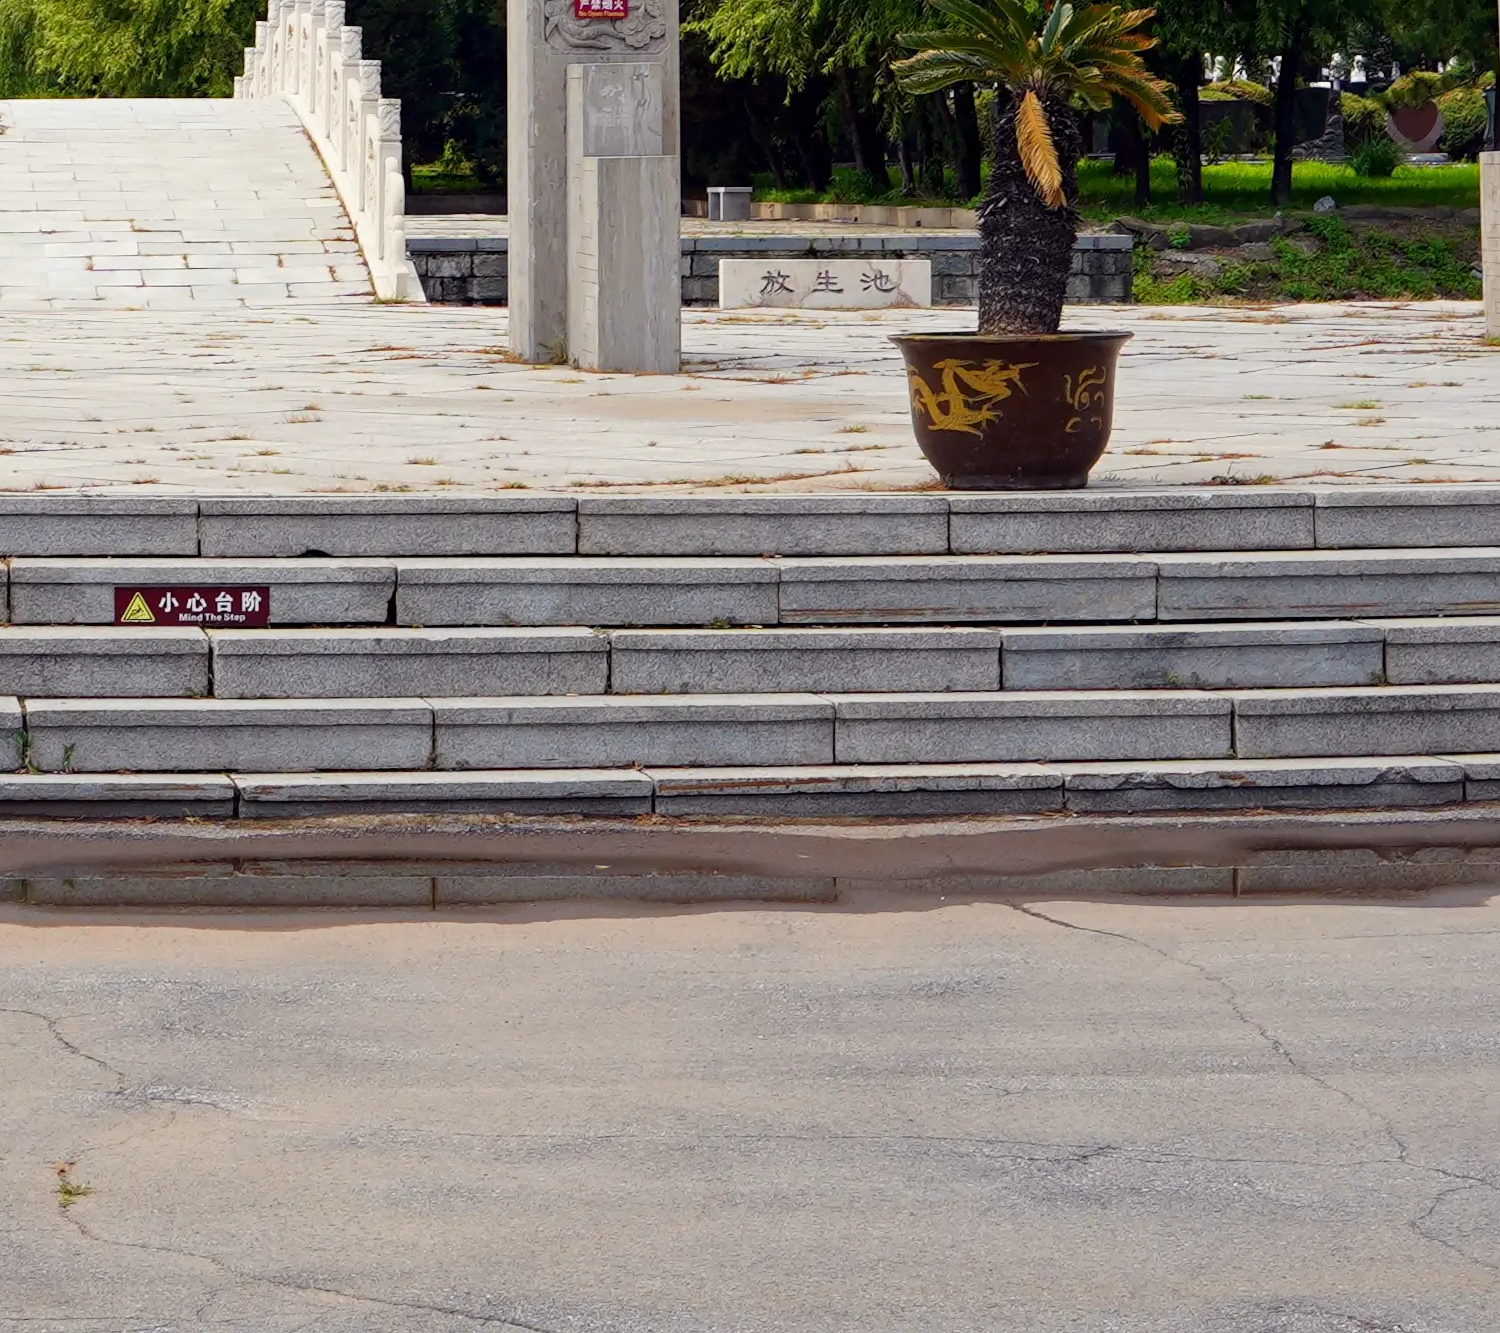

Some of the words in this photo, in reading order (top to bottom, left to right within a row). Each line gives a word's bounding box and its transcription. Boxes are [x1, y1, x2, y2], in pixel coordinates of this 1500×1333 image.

[579, 0, 624, 10] 严禁烟火
[760, 270, 897, 294] 放生池
[158, 591, 262, 613] 小心台阶
[179, 613, 203, 622] Mind
[204, 613, 223, 622] The
[224, 613, 246, 623] Step
